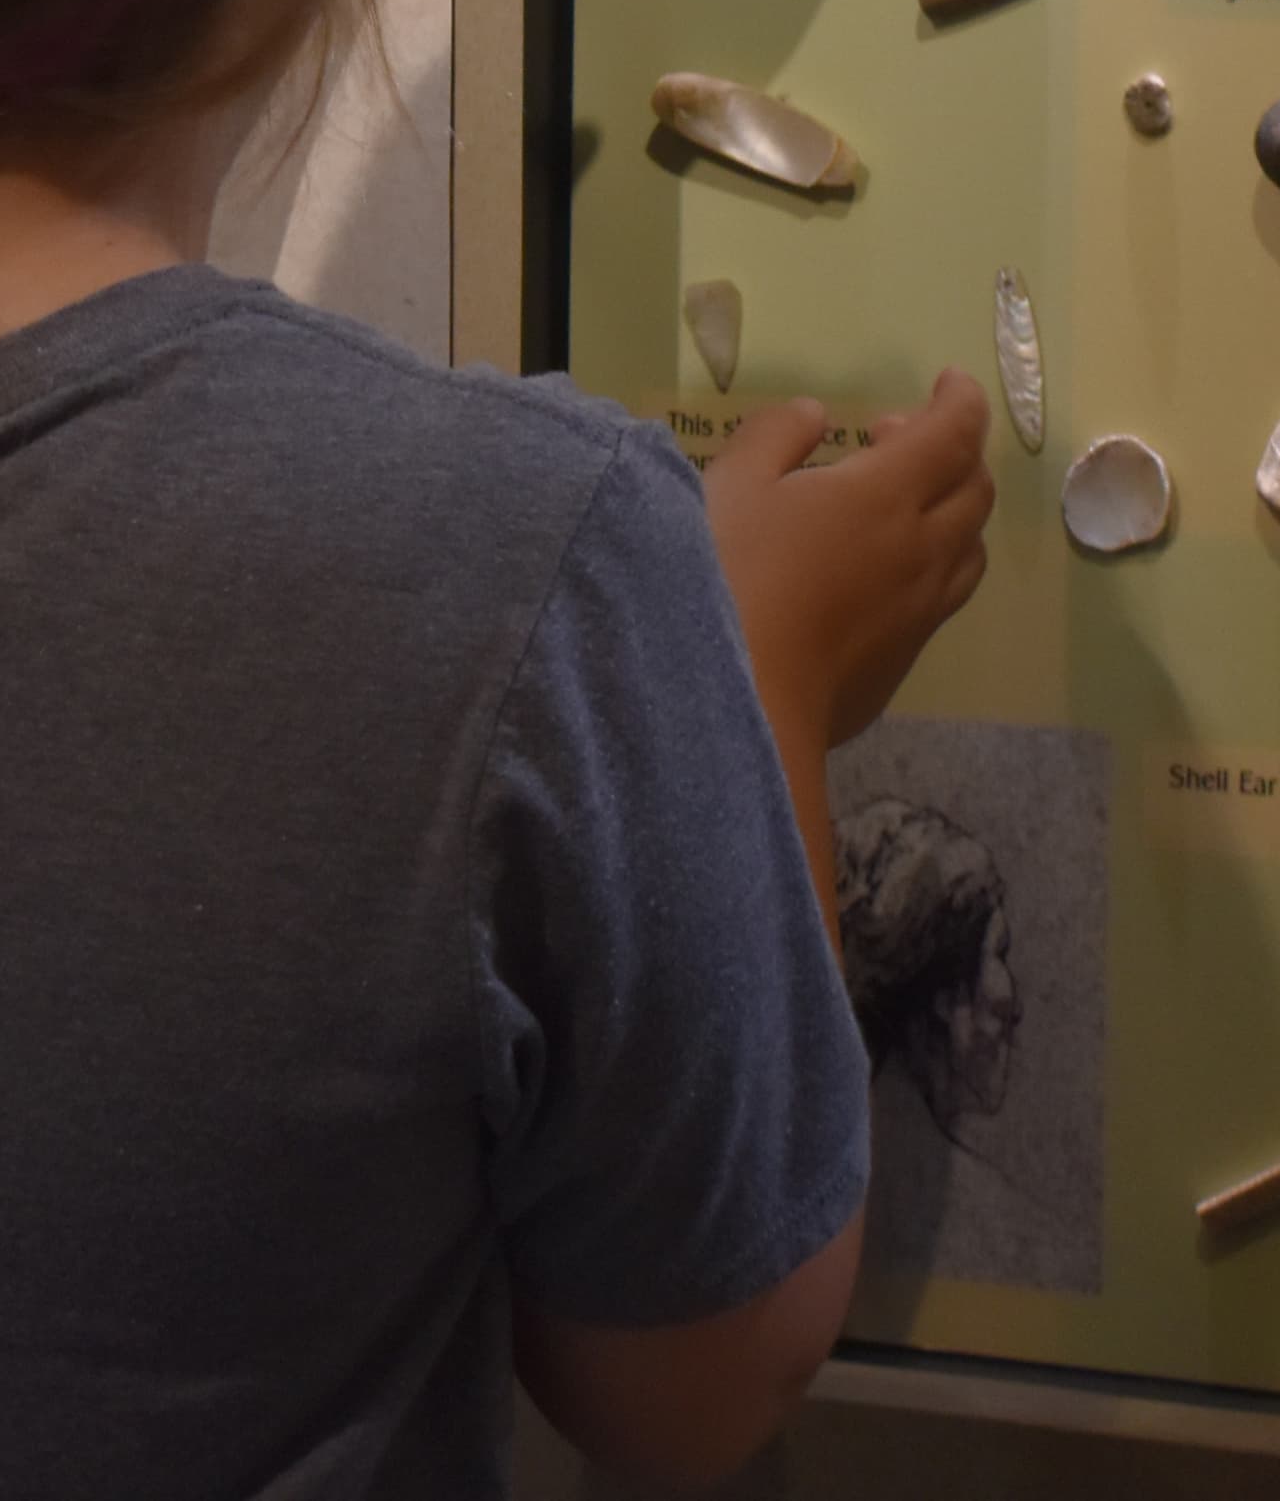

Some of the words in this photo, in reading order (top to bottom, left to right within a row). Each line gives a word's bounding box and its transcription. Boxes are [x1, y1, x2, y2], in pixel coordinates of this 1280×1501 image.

[668, 411, 713, 437] This
[1169, 763, 1228, 792] Shell
[1240, 769, 1276, 795] Ear
